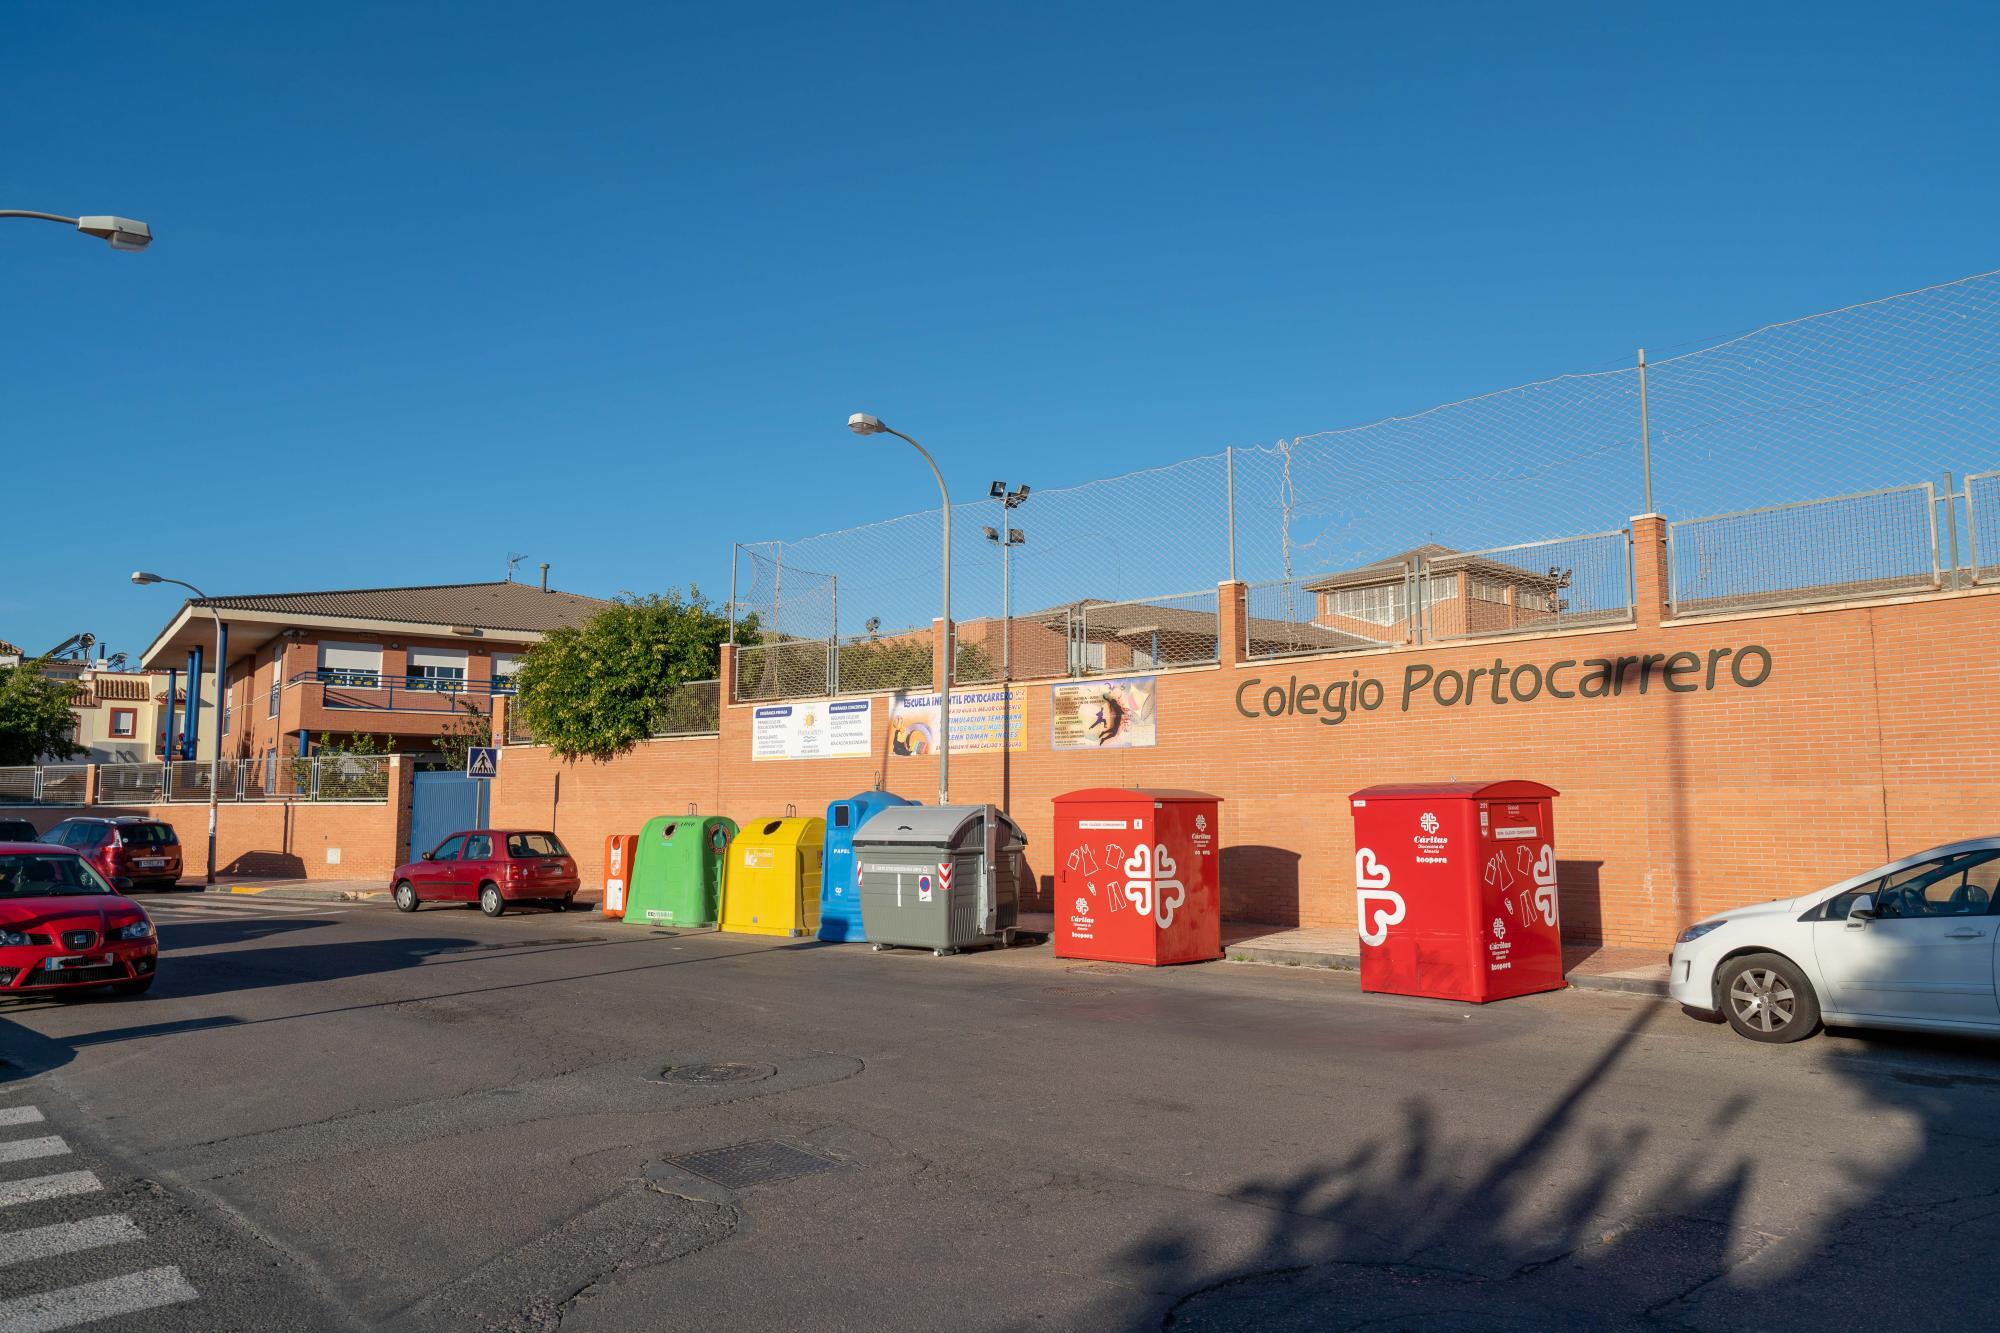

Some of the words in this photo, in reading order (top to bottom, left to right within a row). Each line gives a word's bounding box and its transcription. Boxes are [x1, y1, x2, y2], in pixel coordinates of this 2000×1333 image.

[1235, 669, 1385, 726] Colegio
[1401, 644, 1773, 713] Portocarrero
[903, 697, 931, 708] ESCUELA
[963, 691, 1014, 704] PORTOCARRERO
[1413, 835, 1448, 844] Cáritas
[1070, 915, 1095, 924] Cáritas
